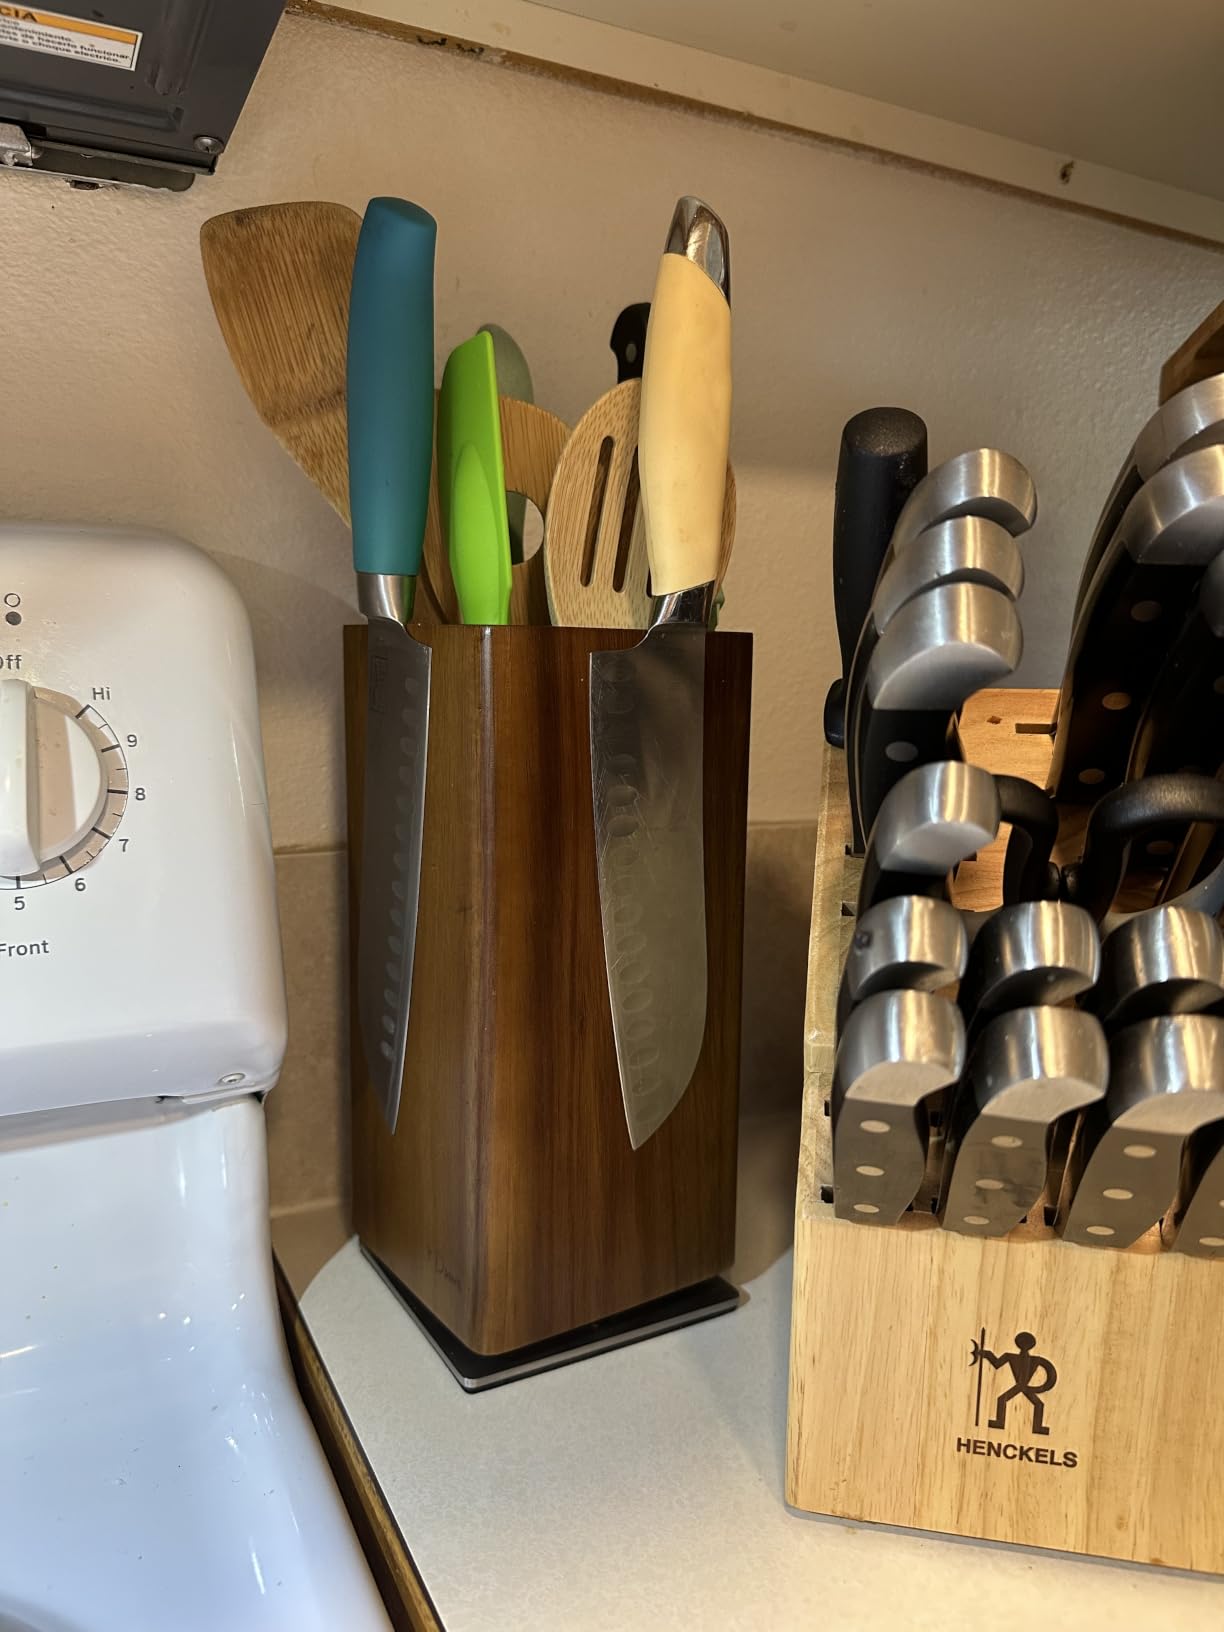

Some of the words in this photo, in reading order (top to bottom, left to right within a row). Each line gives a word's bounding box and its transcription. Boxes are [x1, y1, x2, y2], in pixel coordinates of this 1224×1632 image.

[92, 686, 111, 701] Hi
[127, 734, 138, 748] 9
[135, 788, 146, 801] 8
[119, 839, 130, 852] 7
[75, 878, 86, 892] 6
[14, 897, 25, 910] 5
[957, 1436, 1078, 1469] HENCKELS
